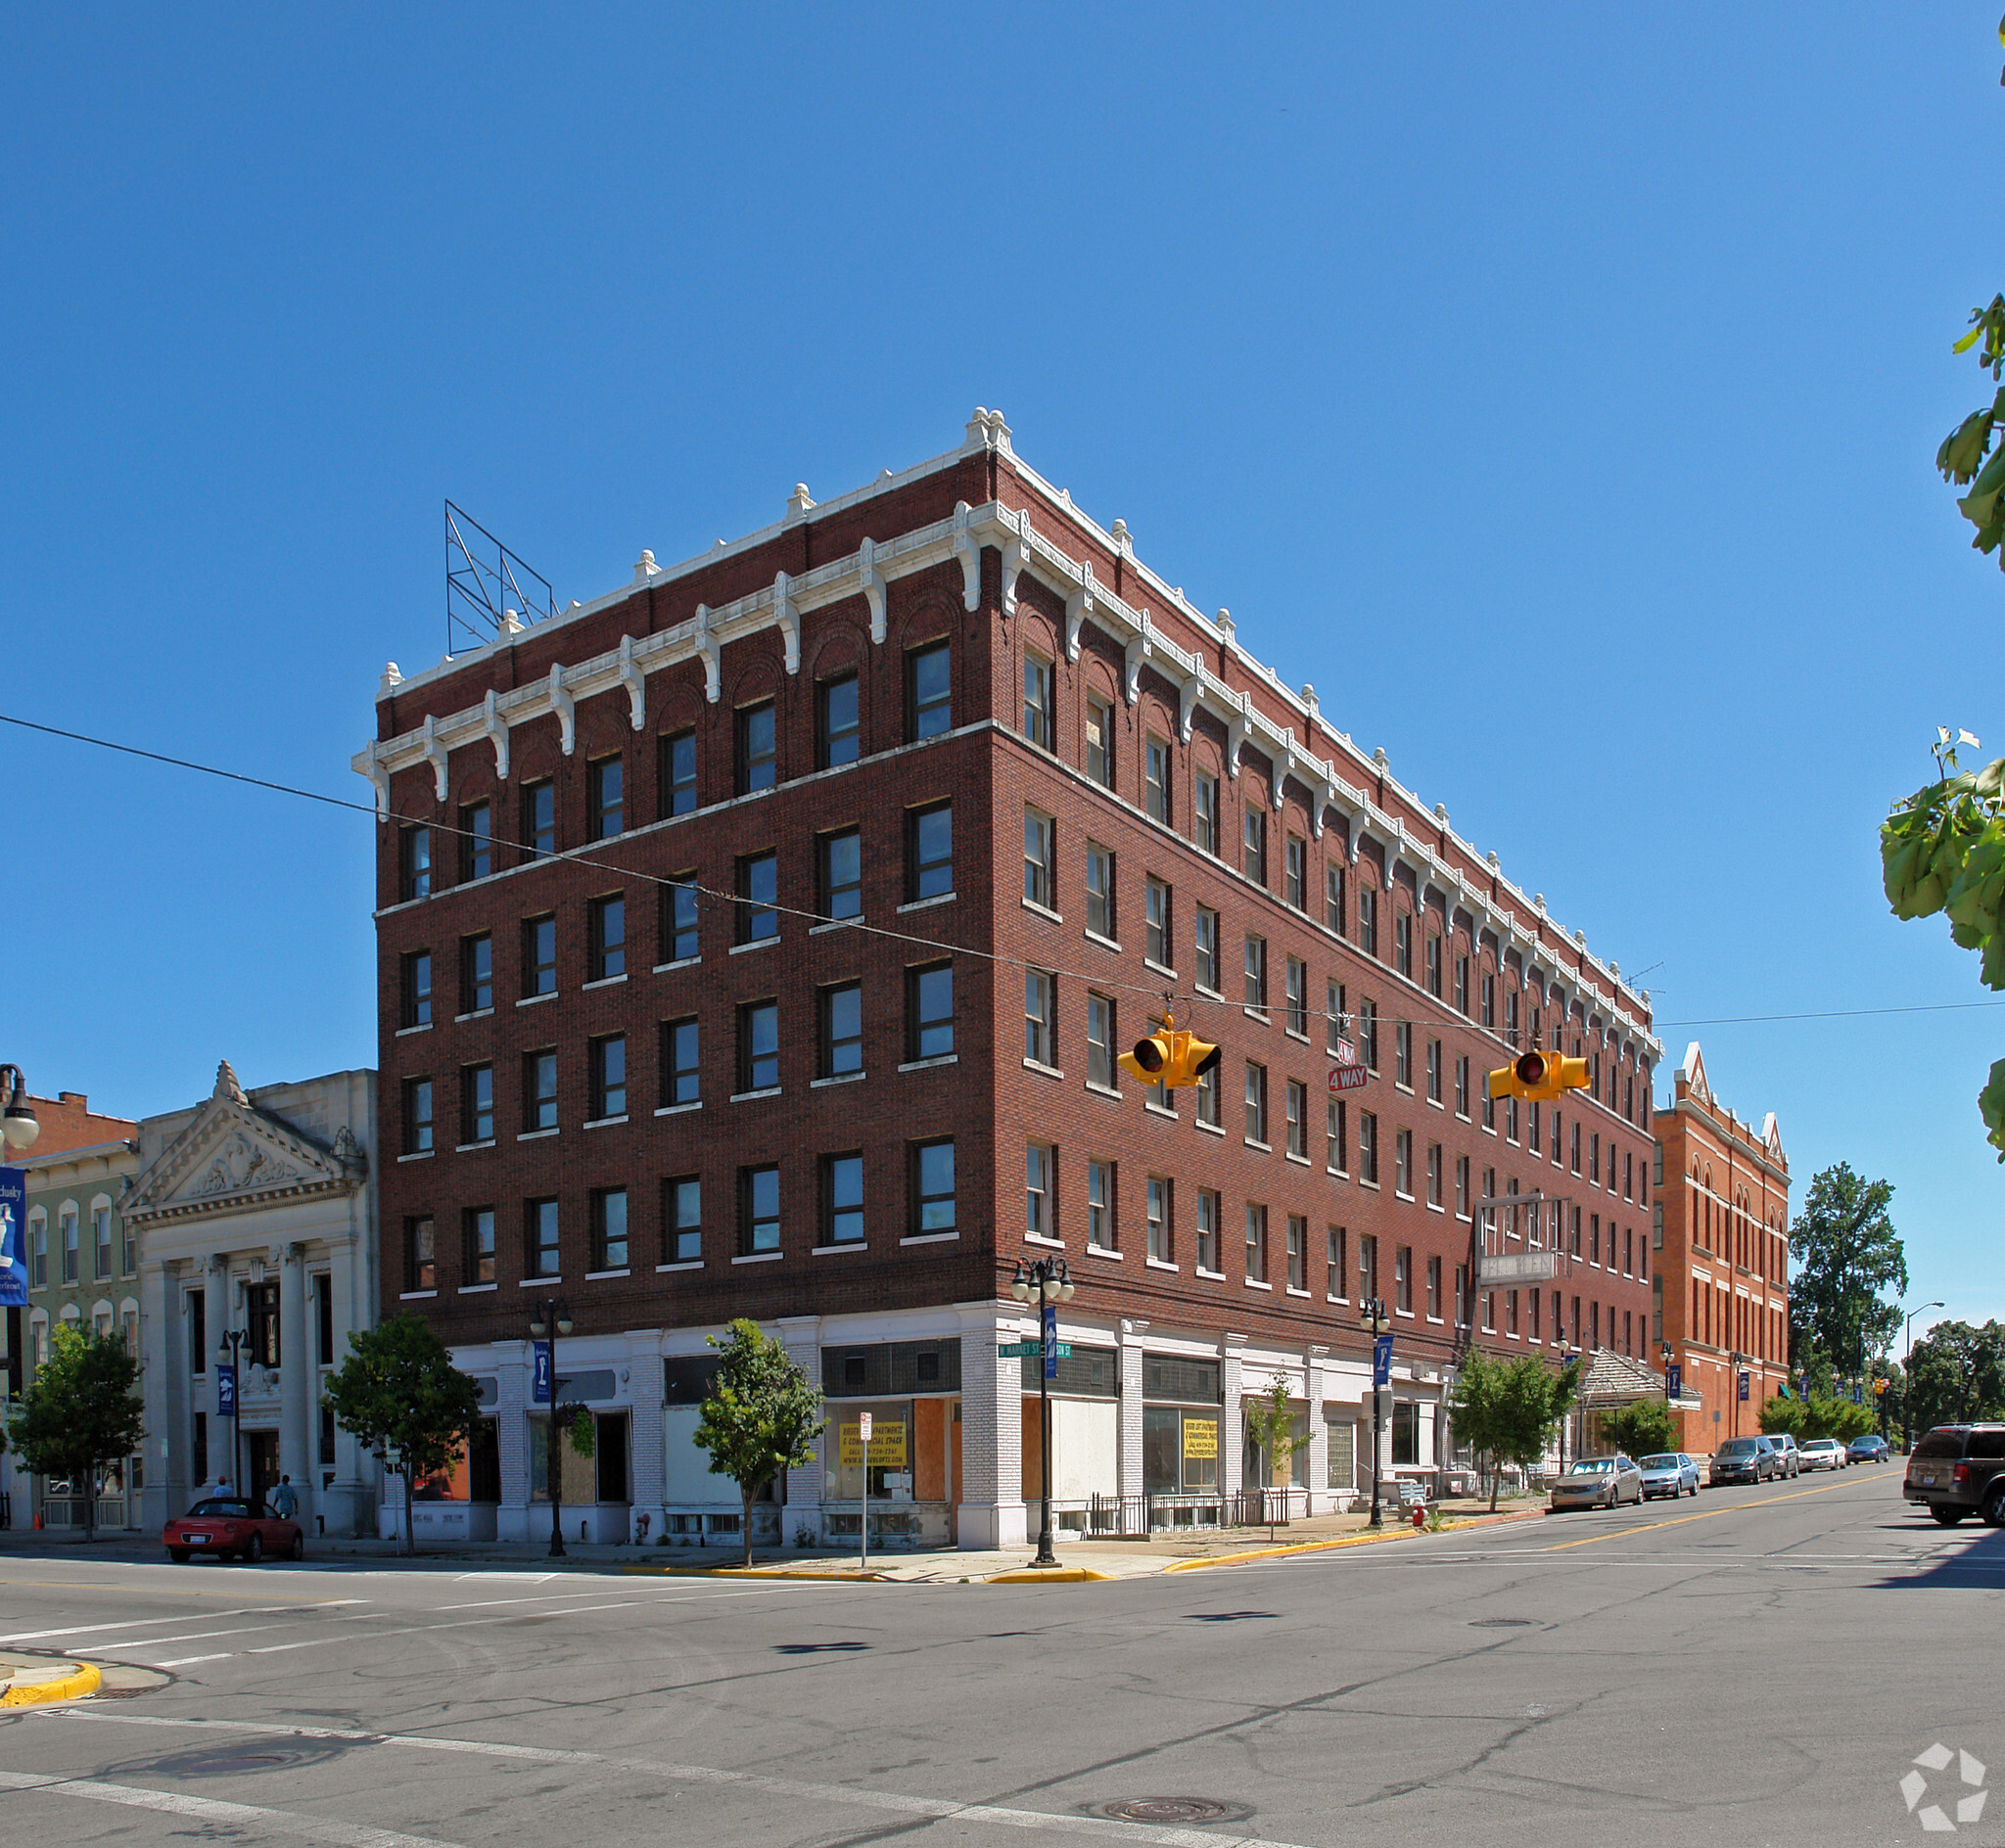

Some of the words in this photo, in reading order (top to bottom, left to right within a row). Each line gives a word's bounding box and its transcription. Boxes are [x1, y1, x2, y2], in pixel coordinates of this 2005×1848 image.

[1330, 1073, 1338, 1088] 4
[1340, 1068, 1365, 1087] WAY
[0, 1184, 22, 1202] dusky
[1007, 1344, 1030, 1355] MARKET
[1032, 1343, 1040, 1354] ST
[885, 1436, 903, 1445] SPACE
